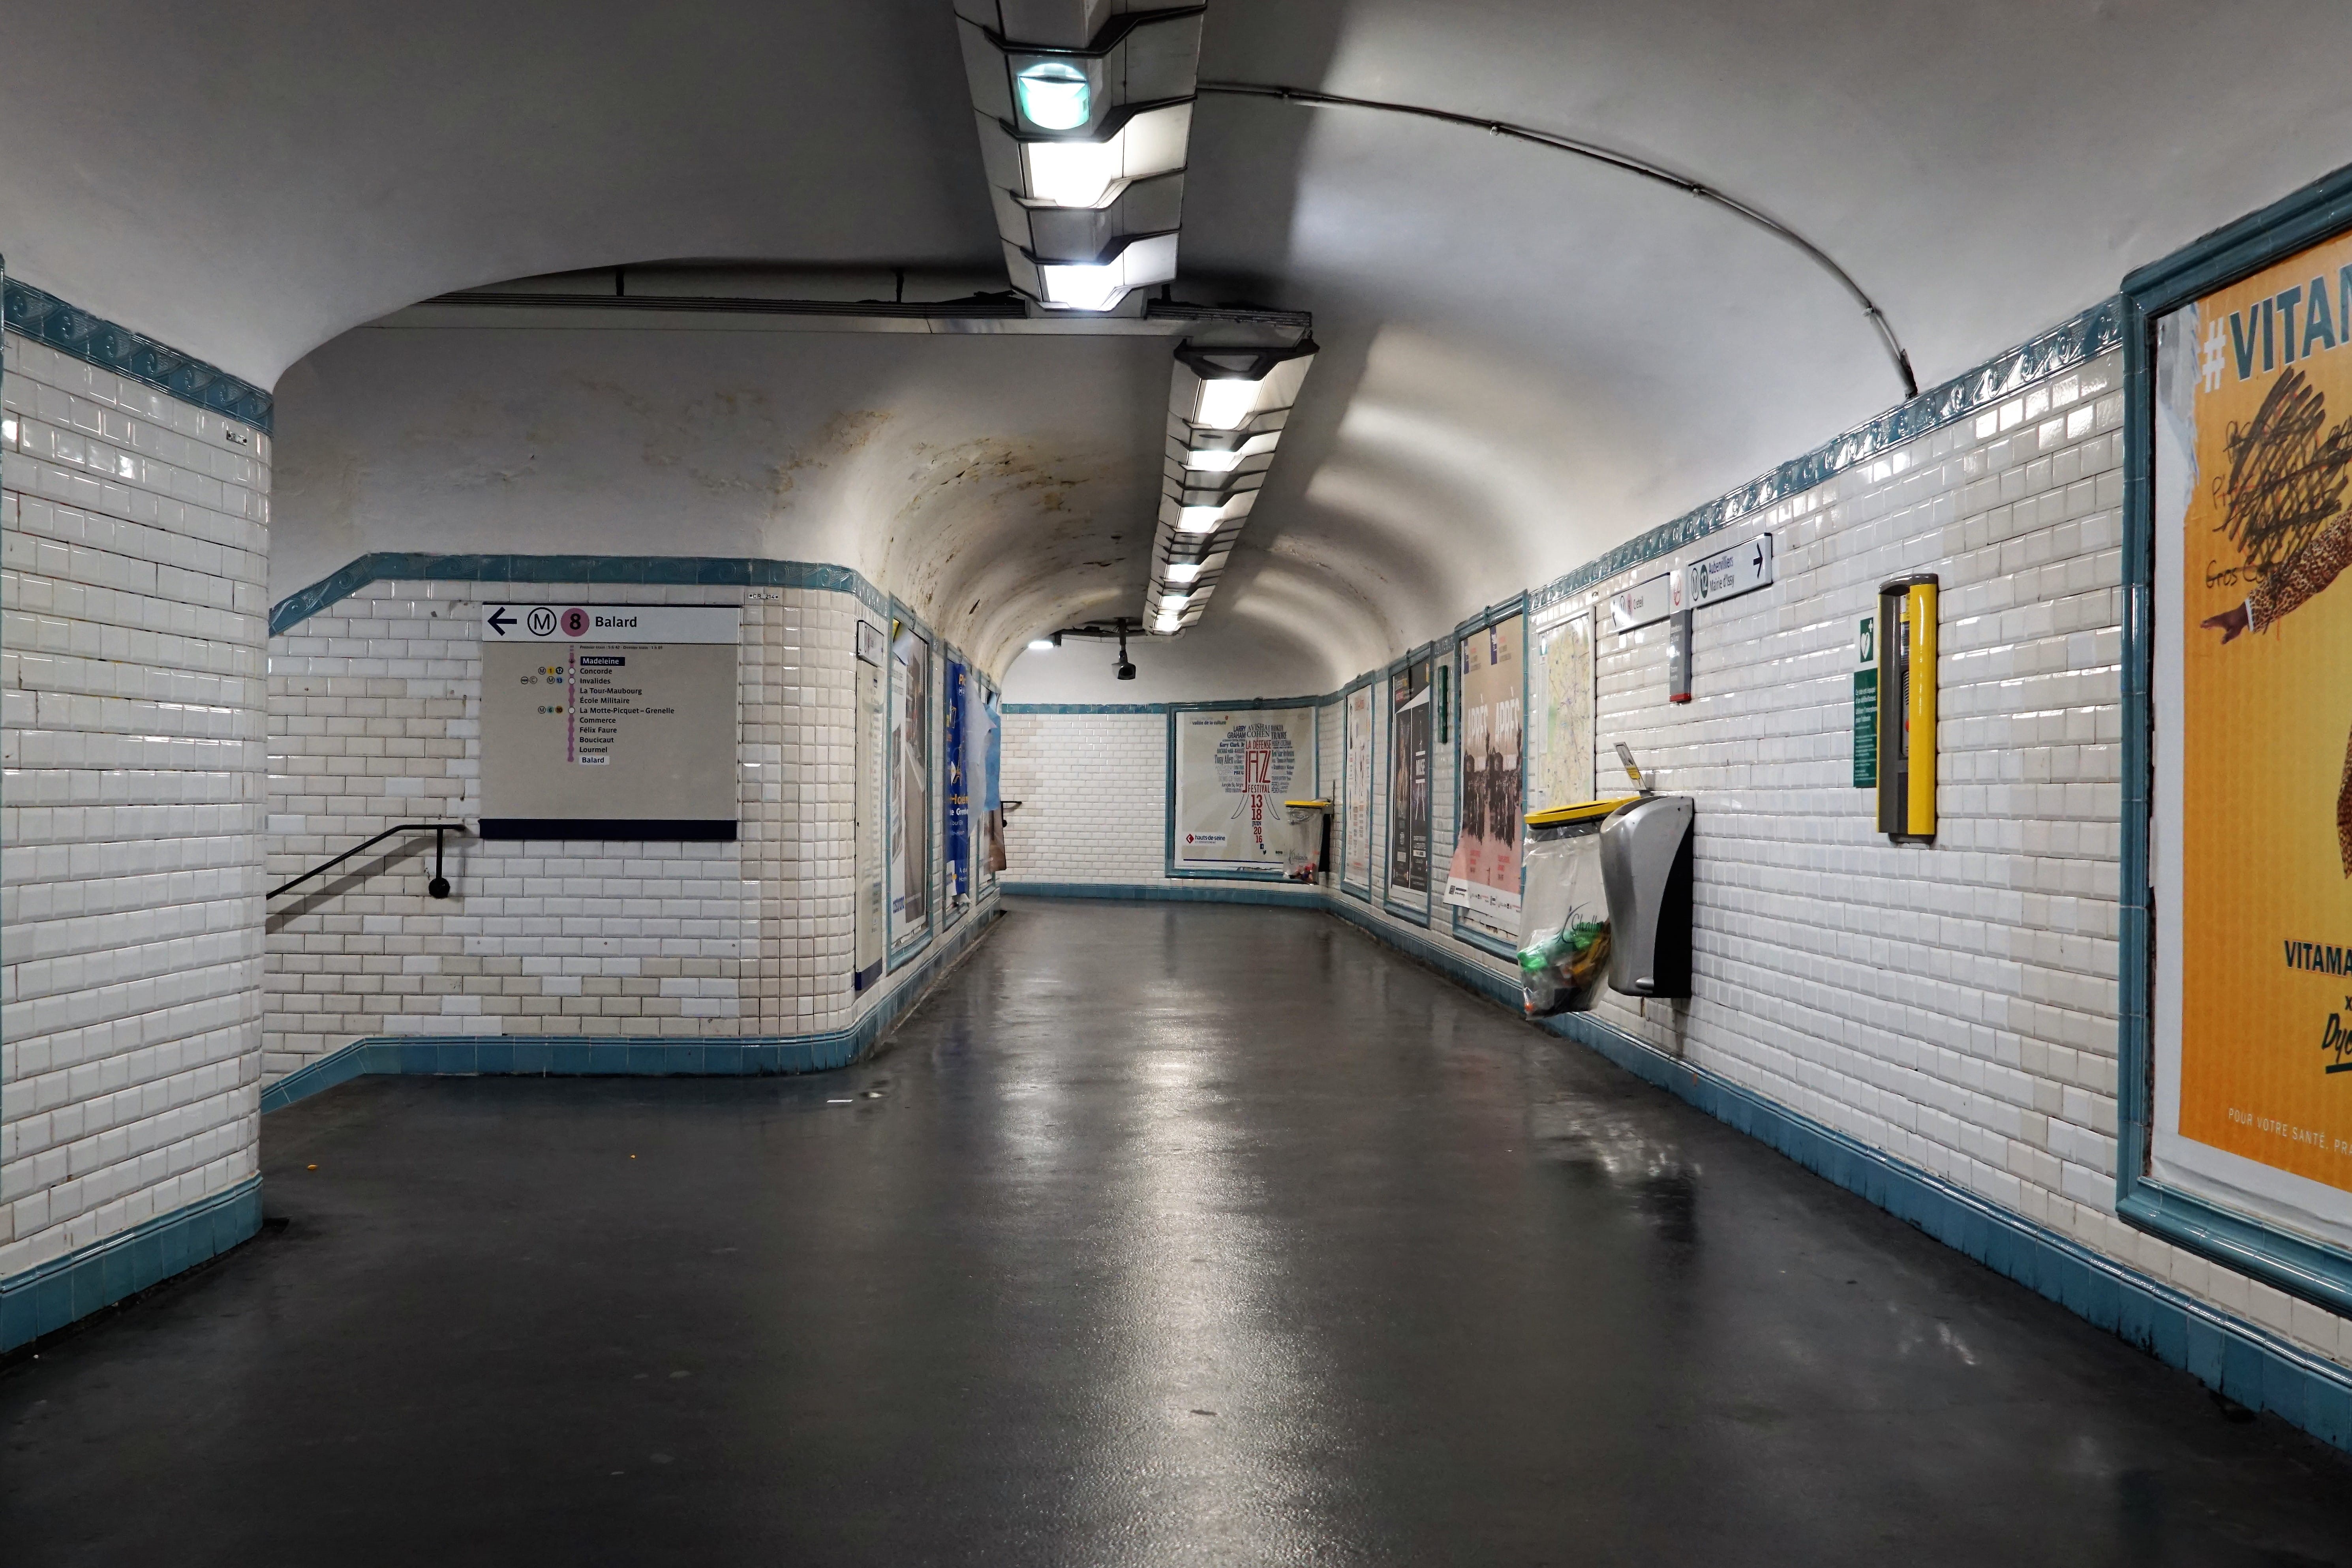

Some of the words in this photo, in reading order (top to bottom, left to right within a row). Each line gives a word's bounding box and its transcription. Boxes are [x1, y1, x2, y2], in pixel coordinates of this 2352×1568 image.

[1701, 571, 1708, 592] 12
[1710, 577, 1722, 592] Mairie
[569, 613, 582, 630] 8
[595, 616, 637, 627] Balard
[1248, 723, 1270, 732] AVISHAI
[1246, 740, 1251, 749] LA
[1253, 737, 1271, 749] DÉFENSE
[1215, 755, 1224, 765] Tony
[1224, 755, 1233, 764] Allen
[1248, 784, 1270, 793] FESTIVAL
[1251, 794, 1263, 808] 13
[1251, 808, 1262, 821] 18
[1254, 826, 1262, 835] 20
[2228, 1108, 2253, 1125] POUR
[2257, 1117, 2288, 1137] VOTRE
[2334, 1139, 2352, 1157] PR
